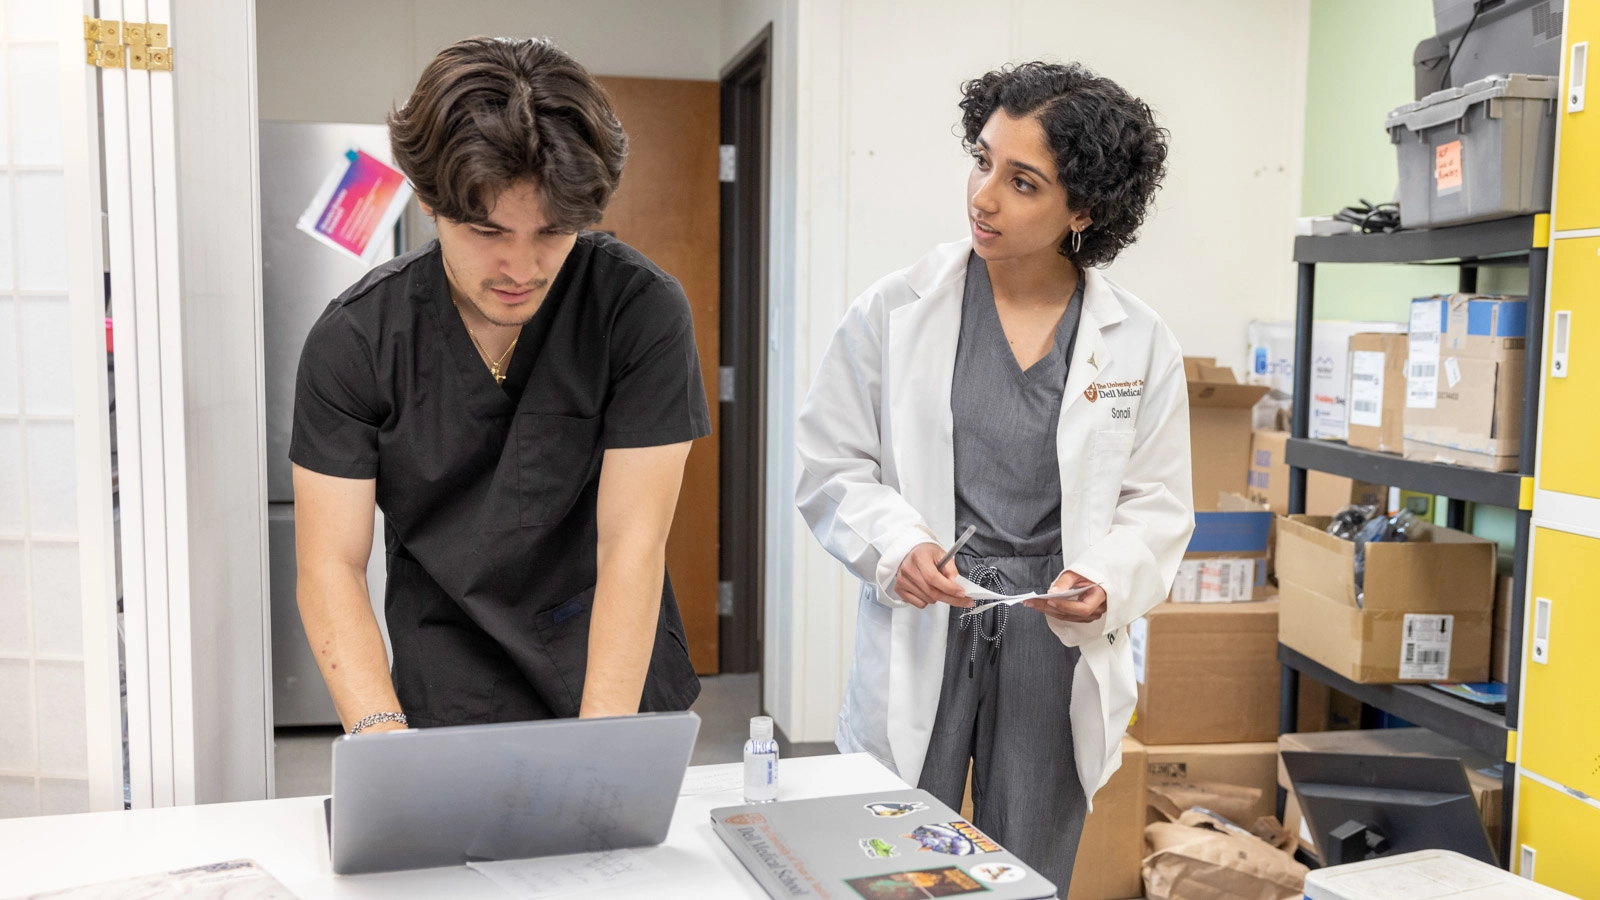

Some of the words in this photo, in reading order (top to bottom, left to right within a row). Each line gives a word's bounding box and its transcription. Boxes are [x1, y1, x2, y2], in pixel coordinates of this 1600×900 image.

[1099, 389, 1116, 398] Dell
[1116, 388, 1141, 396] Medical
[1112, 407, 1130, 418] Sonali
[949, 821, 1002, 852] AUSTIN
[737, 826, 764, 842] Dell
[752, 840, 788, 870] Medical
[773, 867, 810, 897] School
